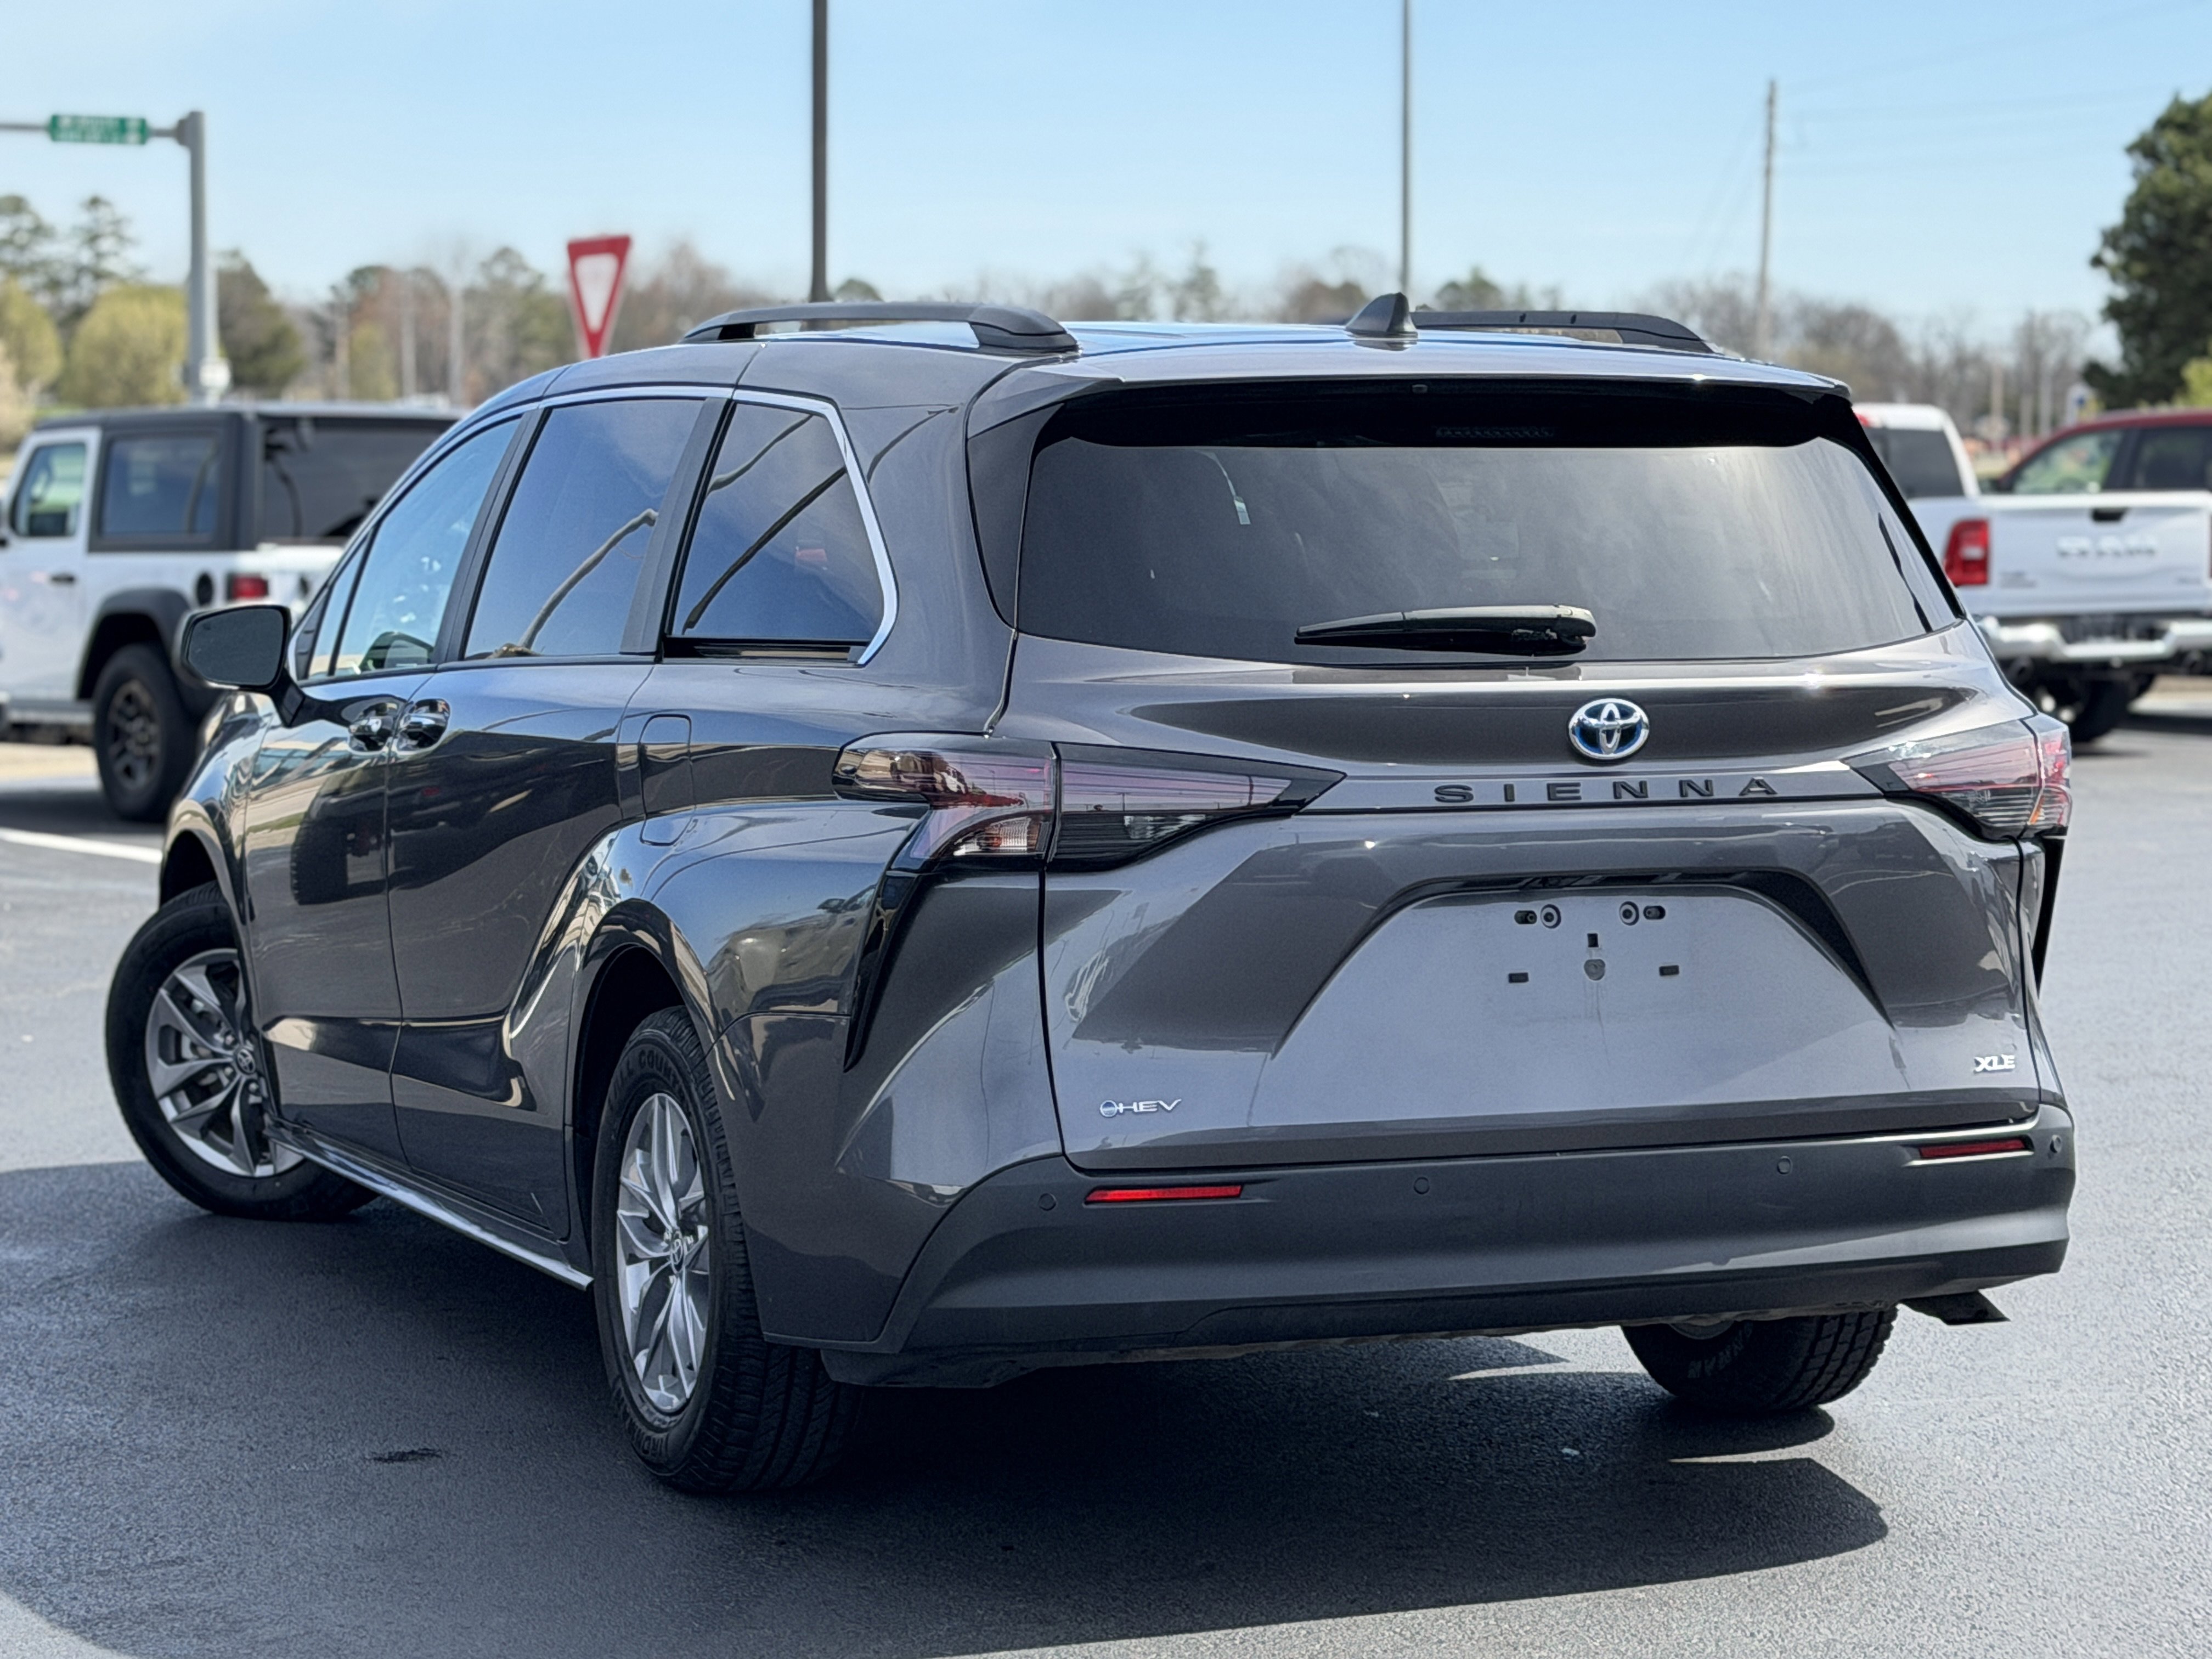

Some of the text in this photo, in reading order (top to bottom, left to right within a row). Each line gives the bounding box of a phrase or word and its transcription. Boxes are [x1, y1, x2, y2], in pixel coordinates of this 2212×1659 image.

[1434, 776, 1777, 804] SIENNA
[1974, 1054, 2016, 1072] XLE
[1118, 1098, 1182, 1114] HEV
